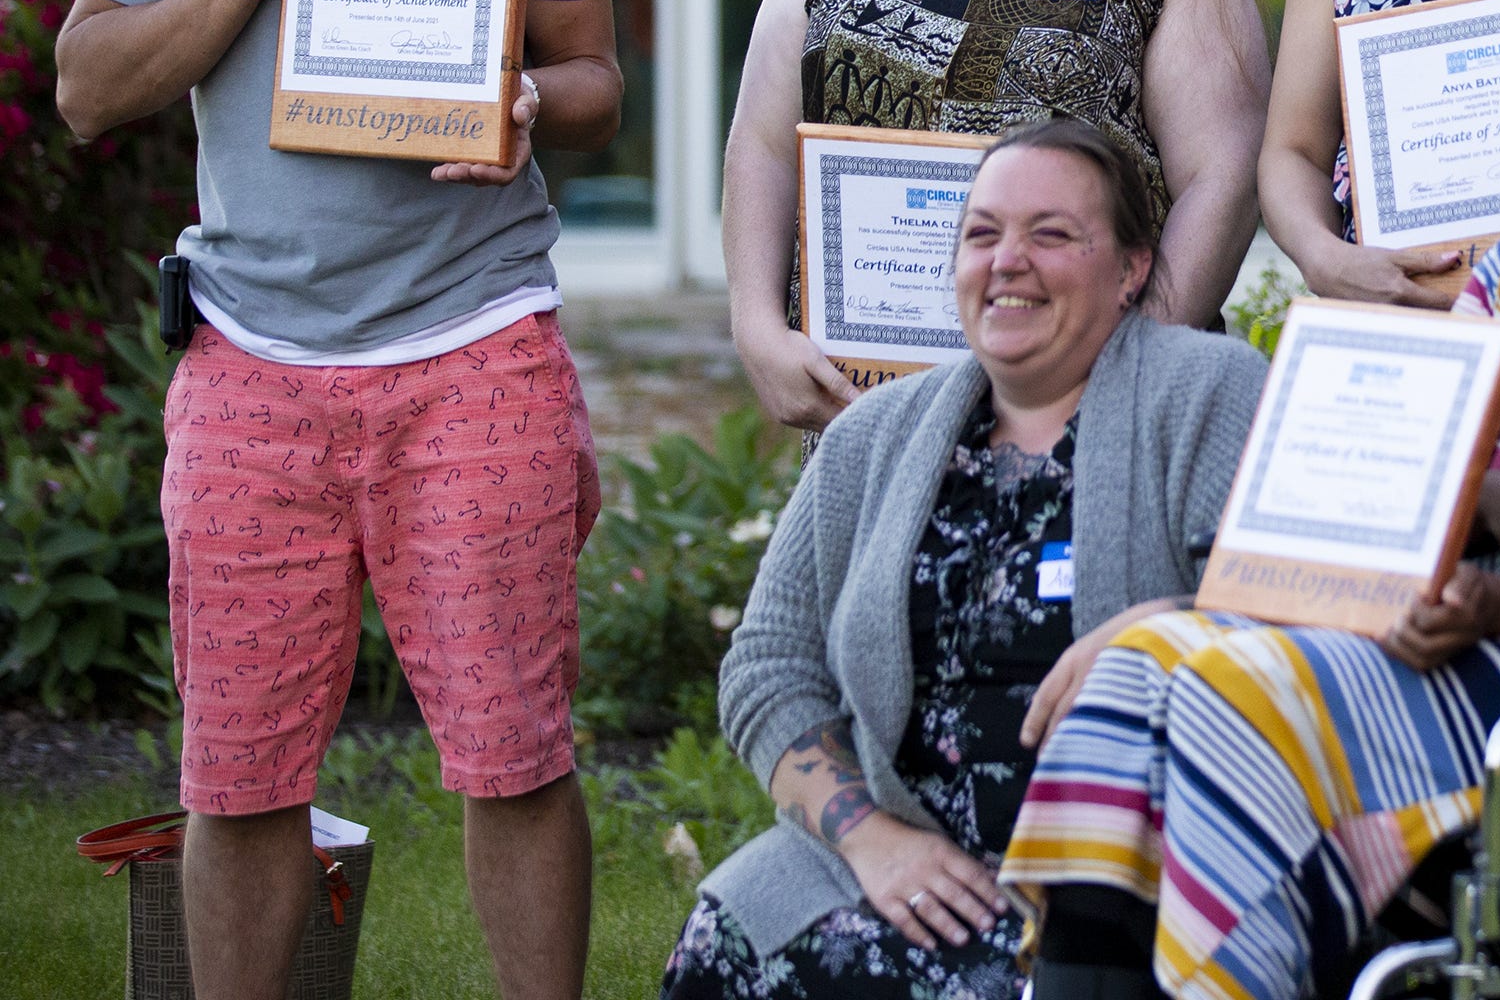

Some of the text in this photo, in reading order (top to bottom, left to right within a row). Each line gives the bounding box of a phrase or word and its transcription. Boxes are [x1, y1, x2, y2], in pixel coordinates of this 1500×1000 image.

[349, 13, 375, 22] Presented
[394, 15, 405, 23] 14th
[412, 16, 425, 24] June
[1442, 82, 1473, 95] ANYA
[286, 98, 485, 142] #unstoppable
[1401, 130, 1473, 153] Certificate
[1476, 122, 1492, 143] of
[927, 189, 968, 202] CIRCLE
[891, 215, 939, 228] THELMA
[872, 227, 911, 237] successfully
[912, 230, 946, 239] completed
[866, 243, 947, 256] Circles USA Network and
[920, 239, 947, 248] required
[854, 258, 926, 275] Certificate
[930, 262, 945, 278] of
[890, 282, 923, 291] Presented
